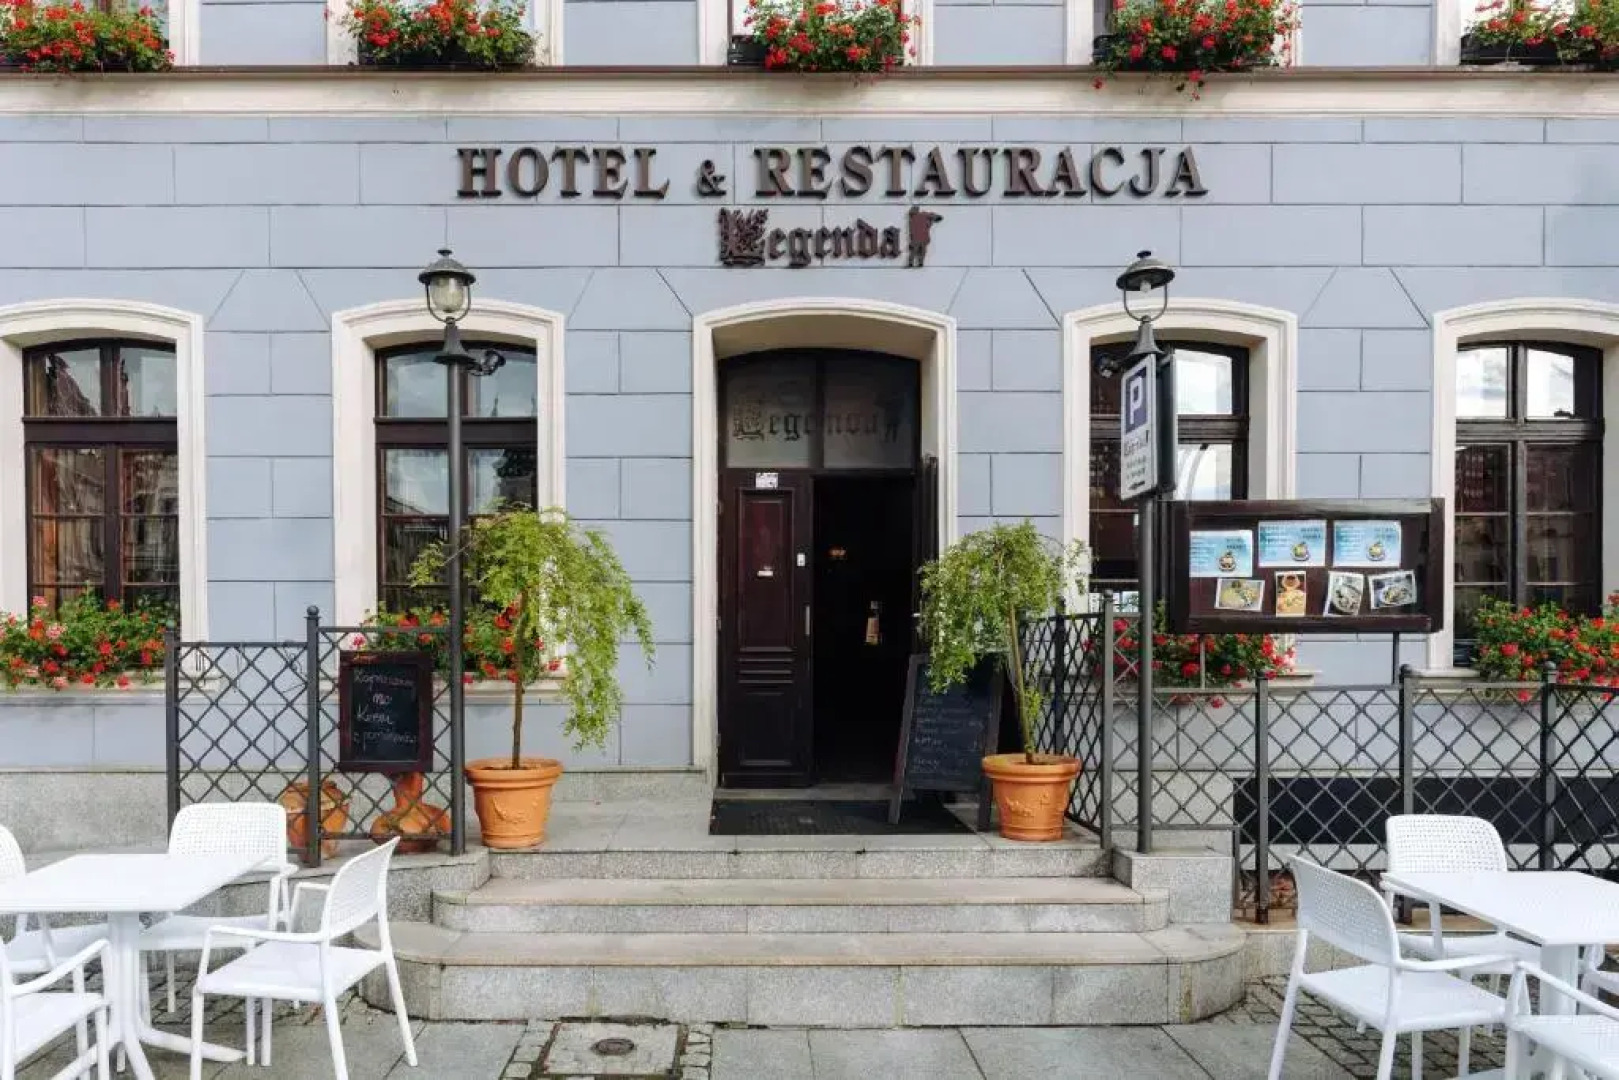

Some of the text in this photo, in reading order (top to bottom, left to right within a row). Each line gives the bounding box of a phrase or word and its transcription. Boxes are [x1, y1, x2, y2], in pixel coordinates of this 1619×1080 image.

[456, 145, 1209, 198] HOTEL & RESTAURACJA
[718, 206, 901, 268] Legenda
[1129, 374, 1143, 426] P
